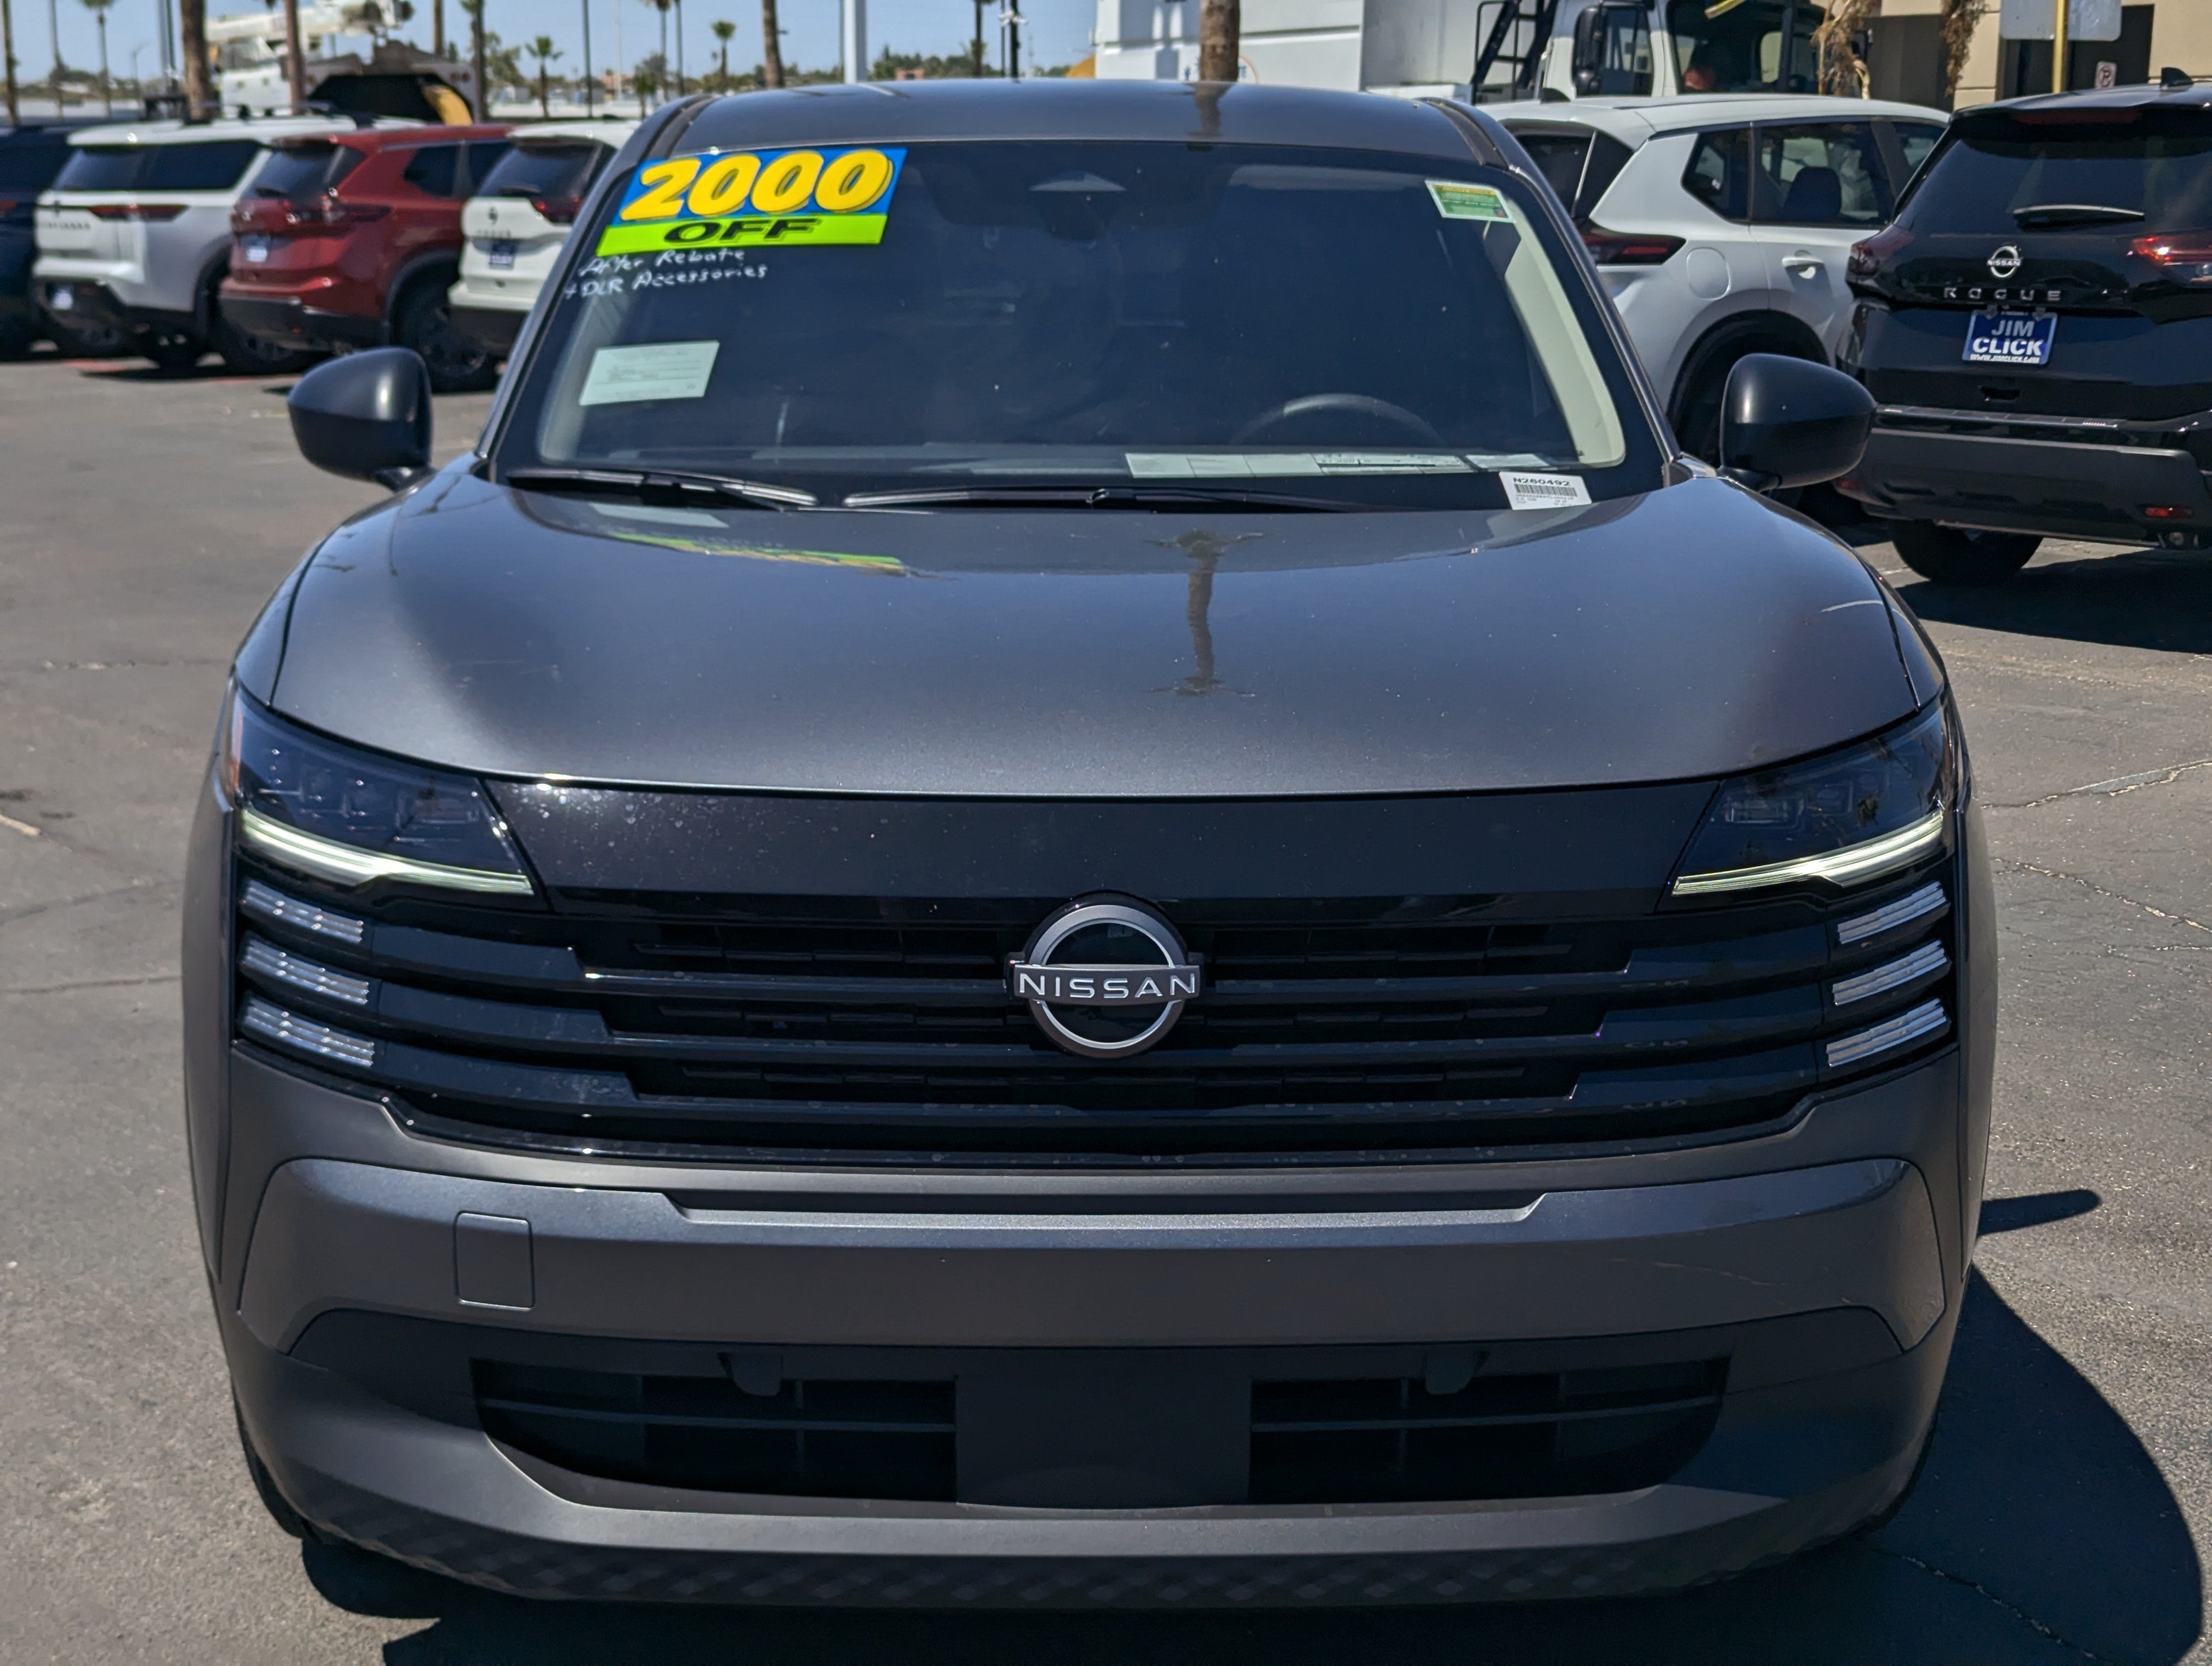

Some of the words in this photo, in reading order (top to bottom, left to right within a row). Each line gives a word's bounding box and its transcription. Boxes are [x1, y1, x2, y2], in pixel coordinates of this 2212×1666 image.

[620, 149, 893, 221] 2000
[664, 217, 823, 244] OFF
[655, 248, 745, 267] Rebate
[1986, 258, 2021, 267] NISSAN
[631, 265, 768, 290] Accessories
[1944, 287, 2061, 302] ROGUE
[1991, 320, 2035, 337] JIM
[1973, 337, 2044, 356] CLICK
[1513, 478, 1571, 486] N260492
[1019, 972, 1195, 999] NISSAN
